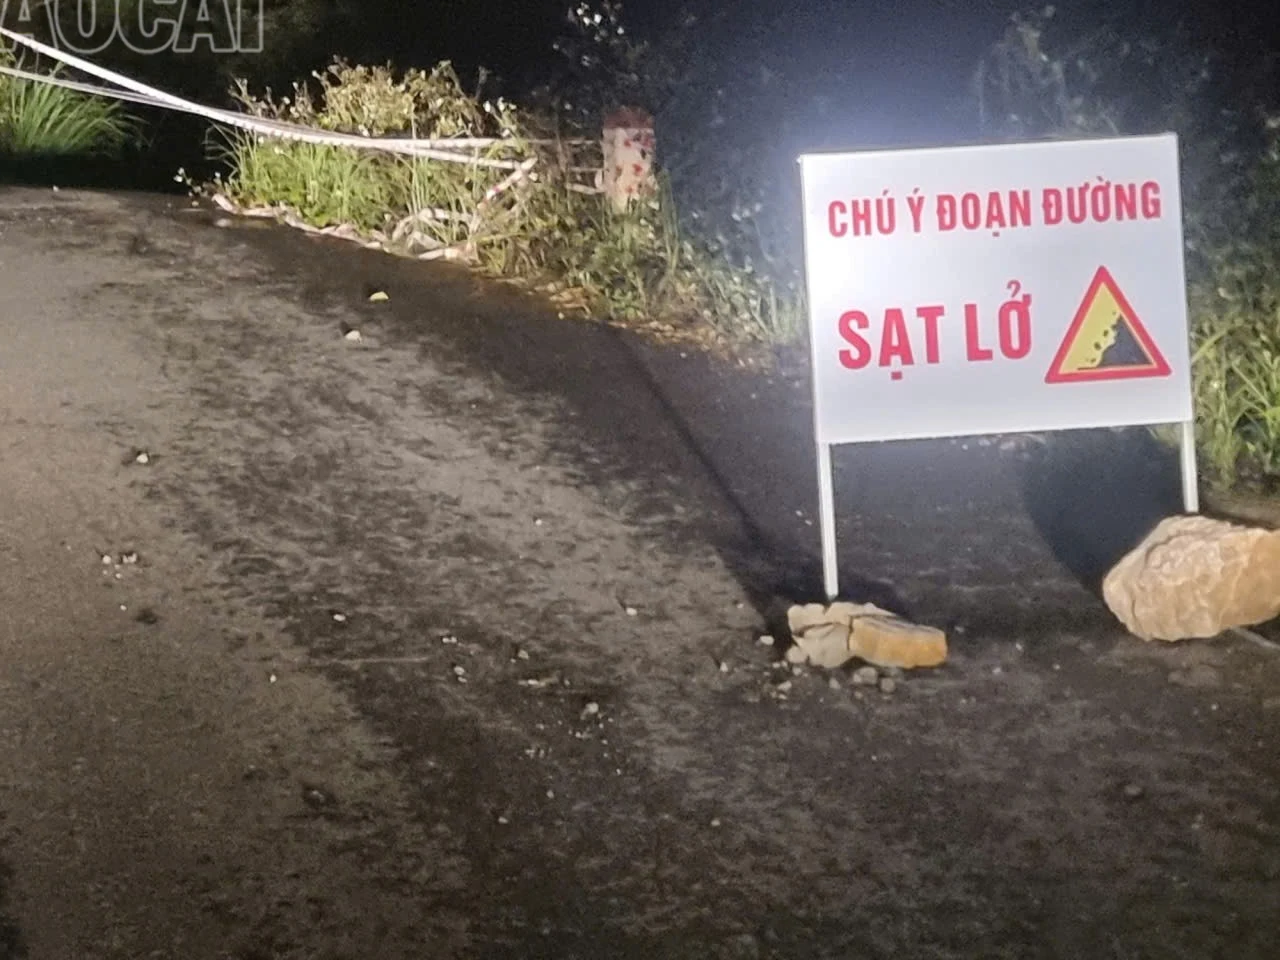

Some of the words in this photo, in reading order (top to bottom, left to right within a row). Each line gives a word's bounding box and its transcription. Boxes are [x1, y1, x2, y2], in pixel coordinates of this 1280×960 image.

[828, 189, 896, 238] CHÚ
[906, 187, 926, 233] Ý
[936, 189, 1032, 237] ĐOẠN
[1042, 176, 1162, 225] ĐƯỜNG
[838, 305, 946, 380] SẠT
[964, 280, 1033, 362] LỞ
